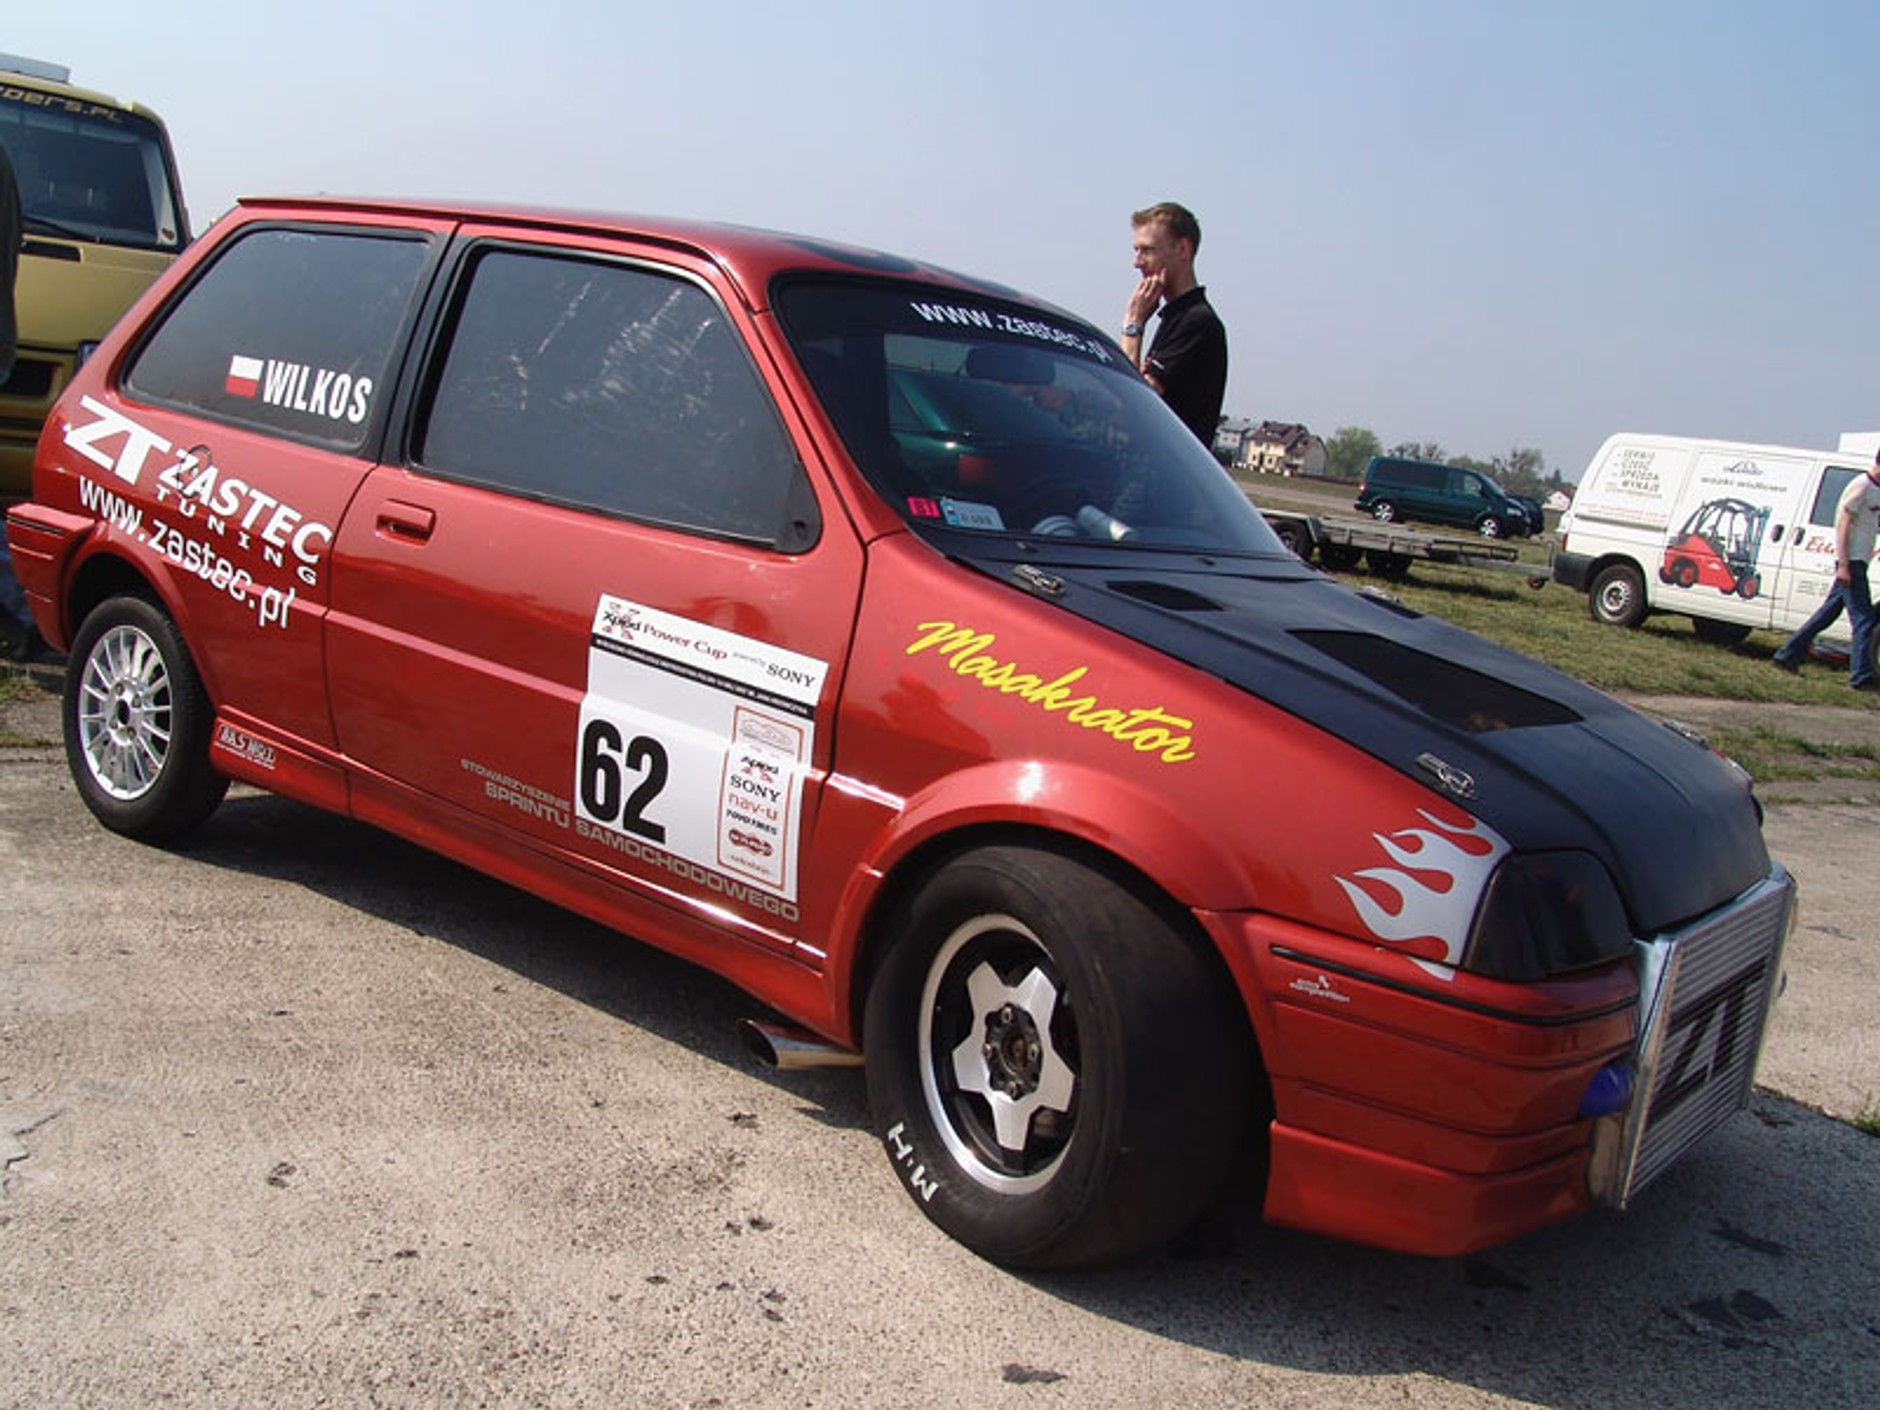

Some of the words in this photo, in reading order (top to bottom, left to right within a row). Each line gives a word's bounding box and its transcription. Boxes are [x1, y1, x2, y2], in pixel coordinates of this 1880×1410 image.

[263, 360, 372, 424] WILKOS
[79, 475, 295, 629] www.zastec.pl
[157, 484, 319, 586] TUNING
[160, 448, 331, 563] ZASTEC
[643, 622, 691, 647] Power
[693, 639, 728, 661] Cup
[766, 663, 816, 688] SONY
[906, 621, 1195, 762] Masakrator
[580, 718, 667, 844] 62
[729, 793, 778, 821] nav-u
[730, 774, 781, 802] SONY
[484, 780, 571, 829] SPRINTU
[575, 820, 800, 922] SAMOCHODOWEGO
